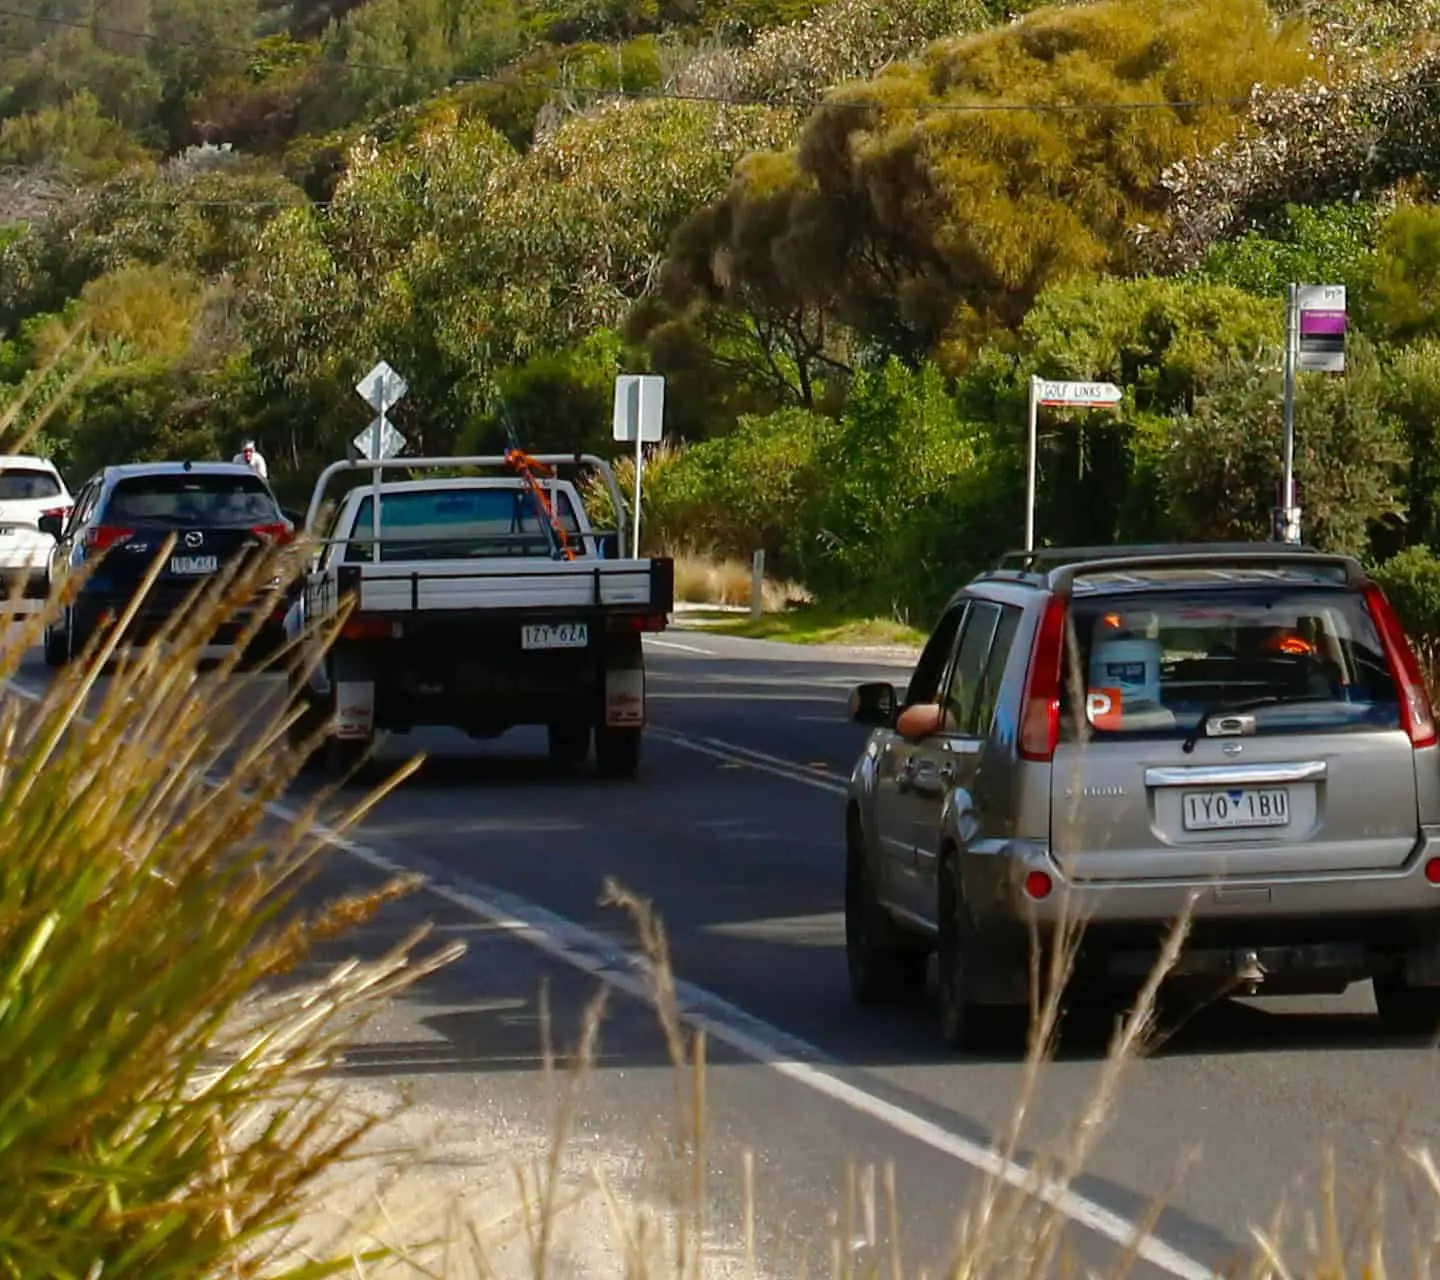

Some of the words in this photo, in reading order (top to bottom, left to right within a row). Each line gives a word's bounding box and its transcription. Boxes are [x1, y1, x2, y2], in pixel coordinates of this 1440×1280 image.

[1045, 383, 1068, 397] GOLF
[1074, 384, 1102, 397] LINKS
[1086, 693, 1112, 724] P
